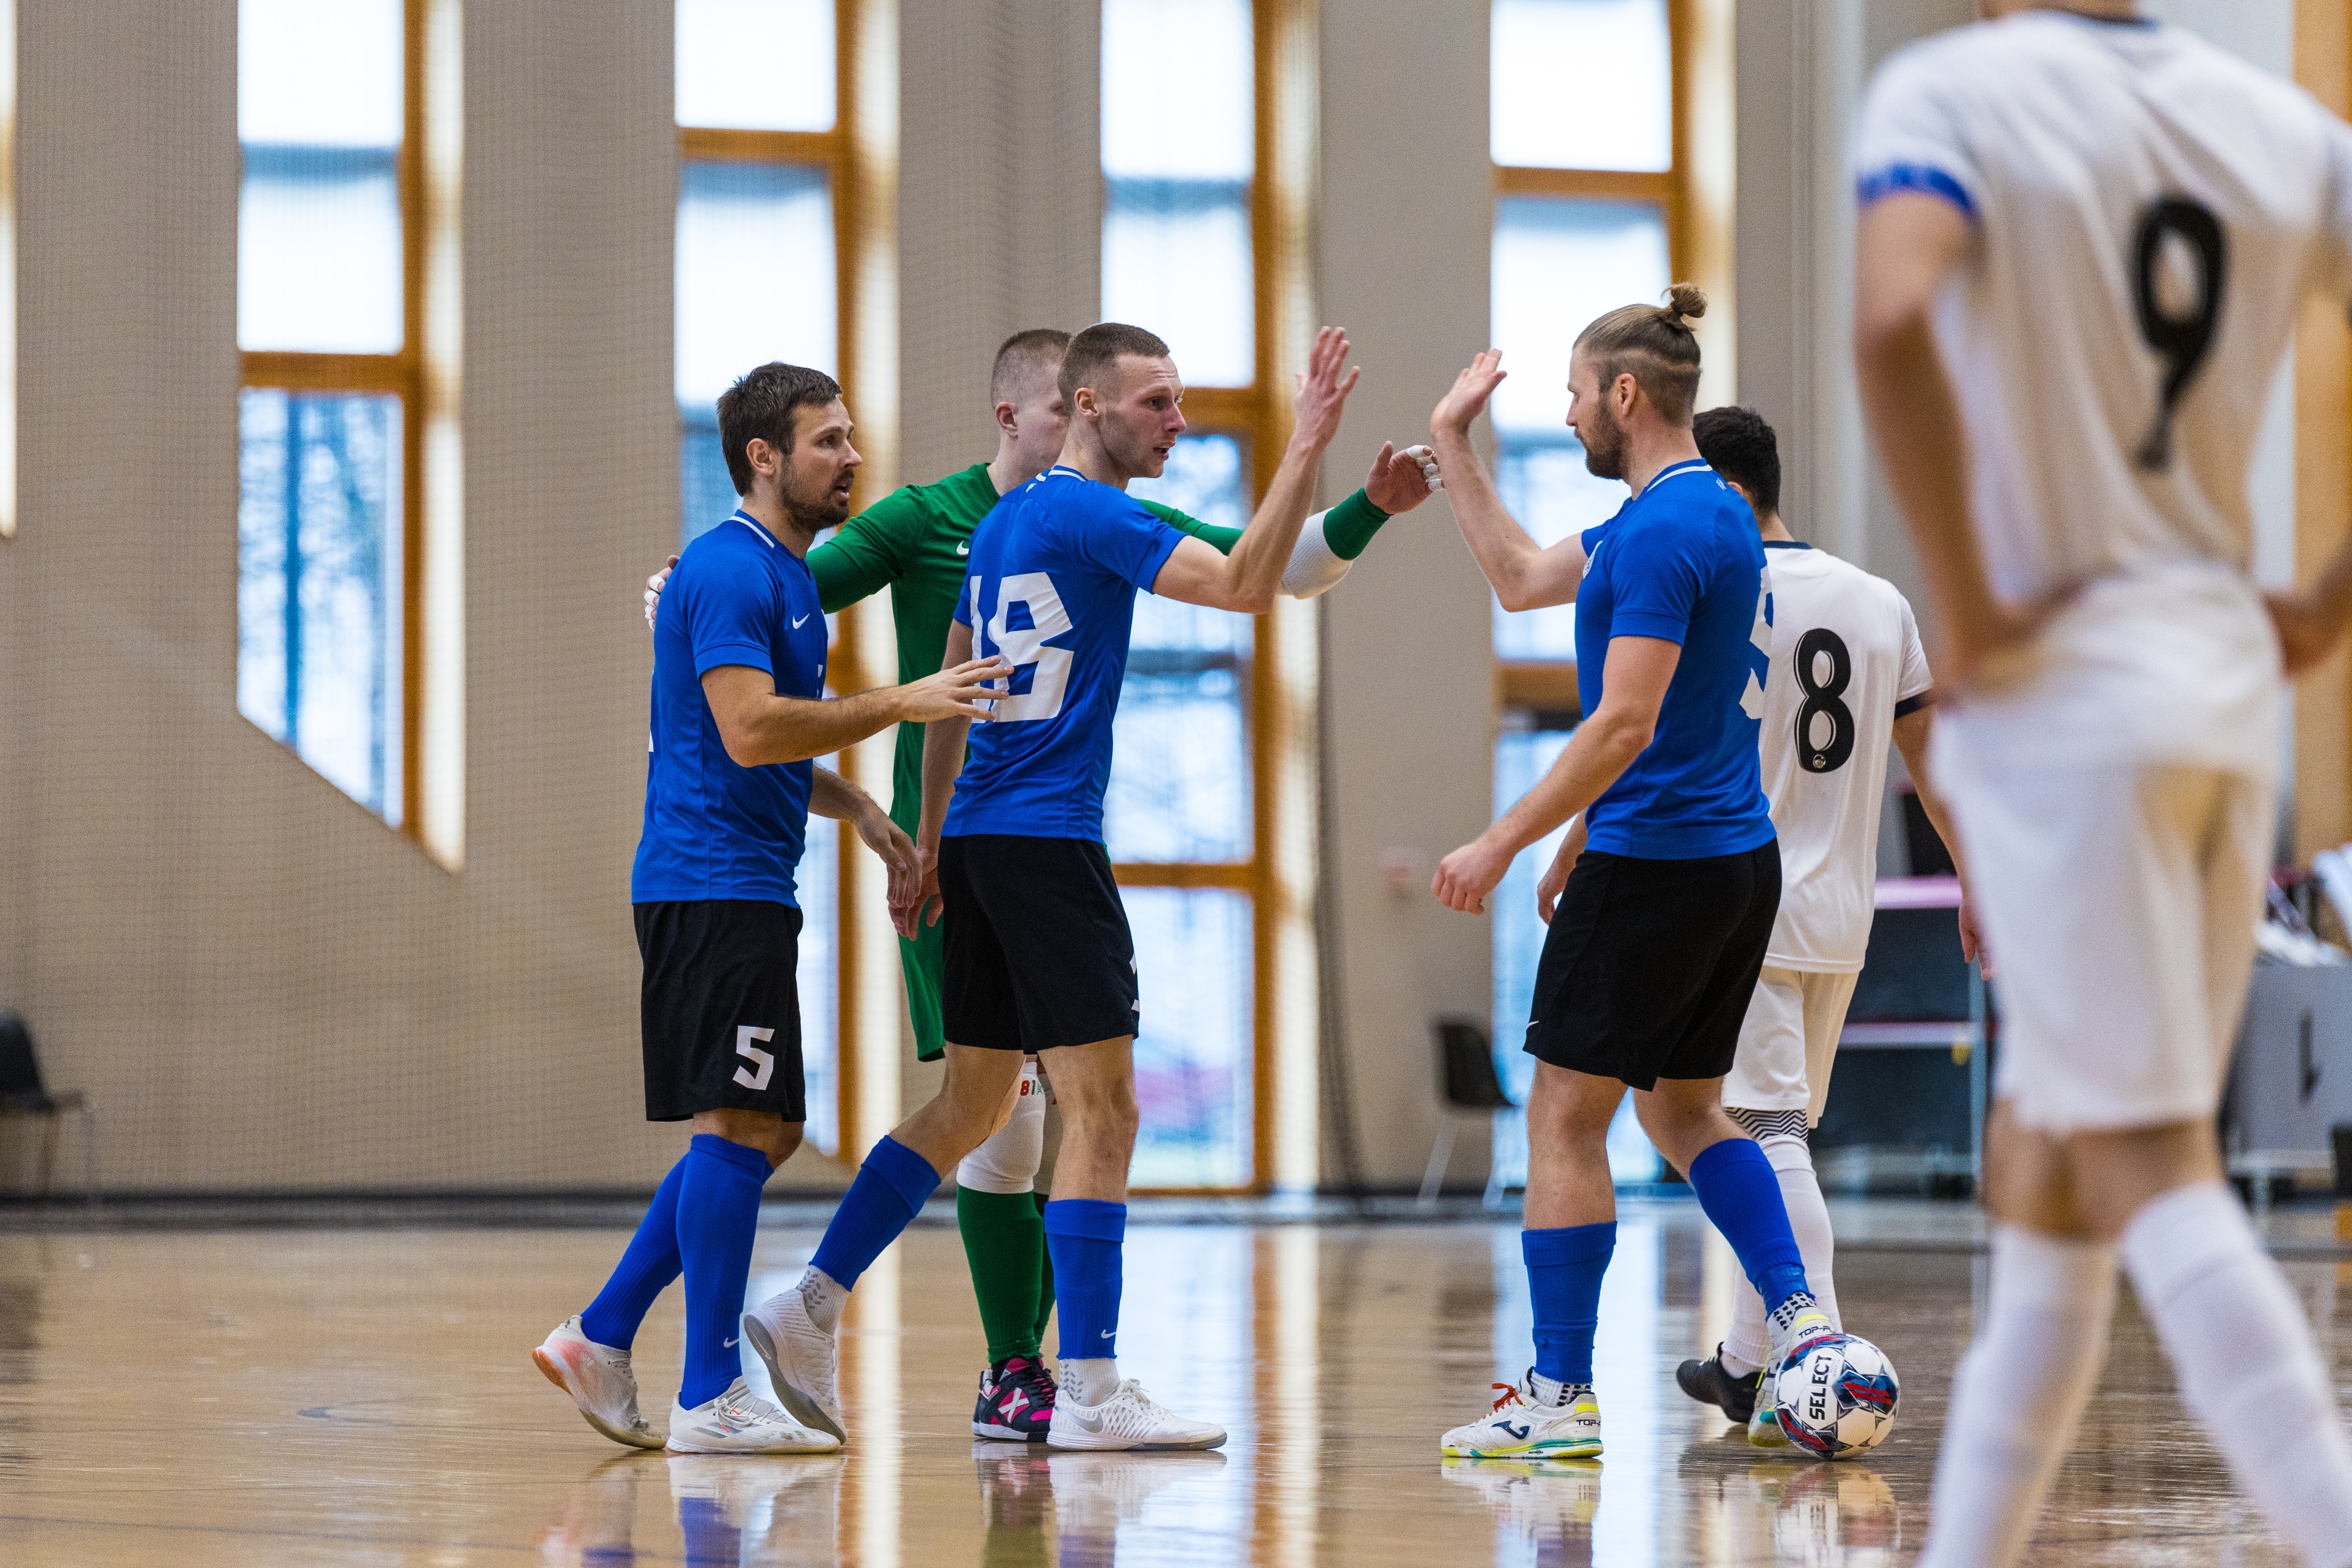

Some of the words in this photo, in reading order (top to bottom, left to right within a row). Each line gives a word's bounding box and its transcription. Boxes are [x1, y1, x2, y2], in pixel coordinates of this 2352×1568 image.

[2131, 195, 2229, 473] 9
[970, 572, 1075, 724] 18
[1793, 628, 1855, 773] 8
[733, 1025, 775, 1091] 5
[1809, 1355, 1832, 1420] SELECT
